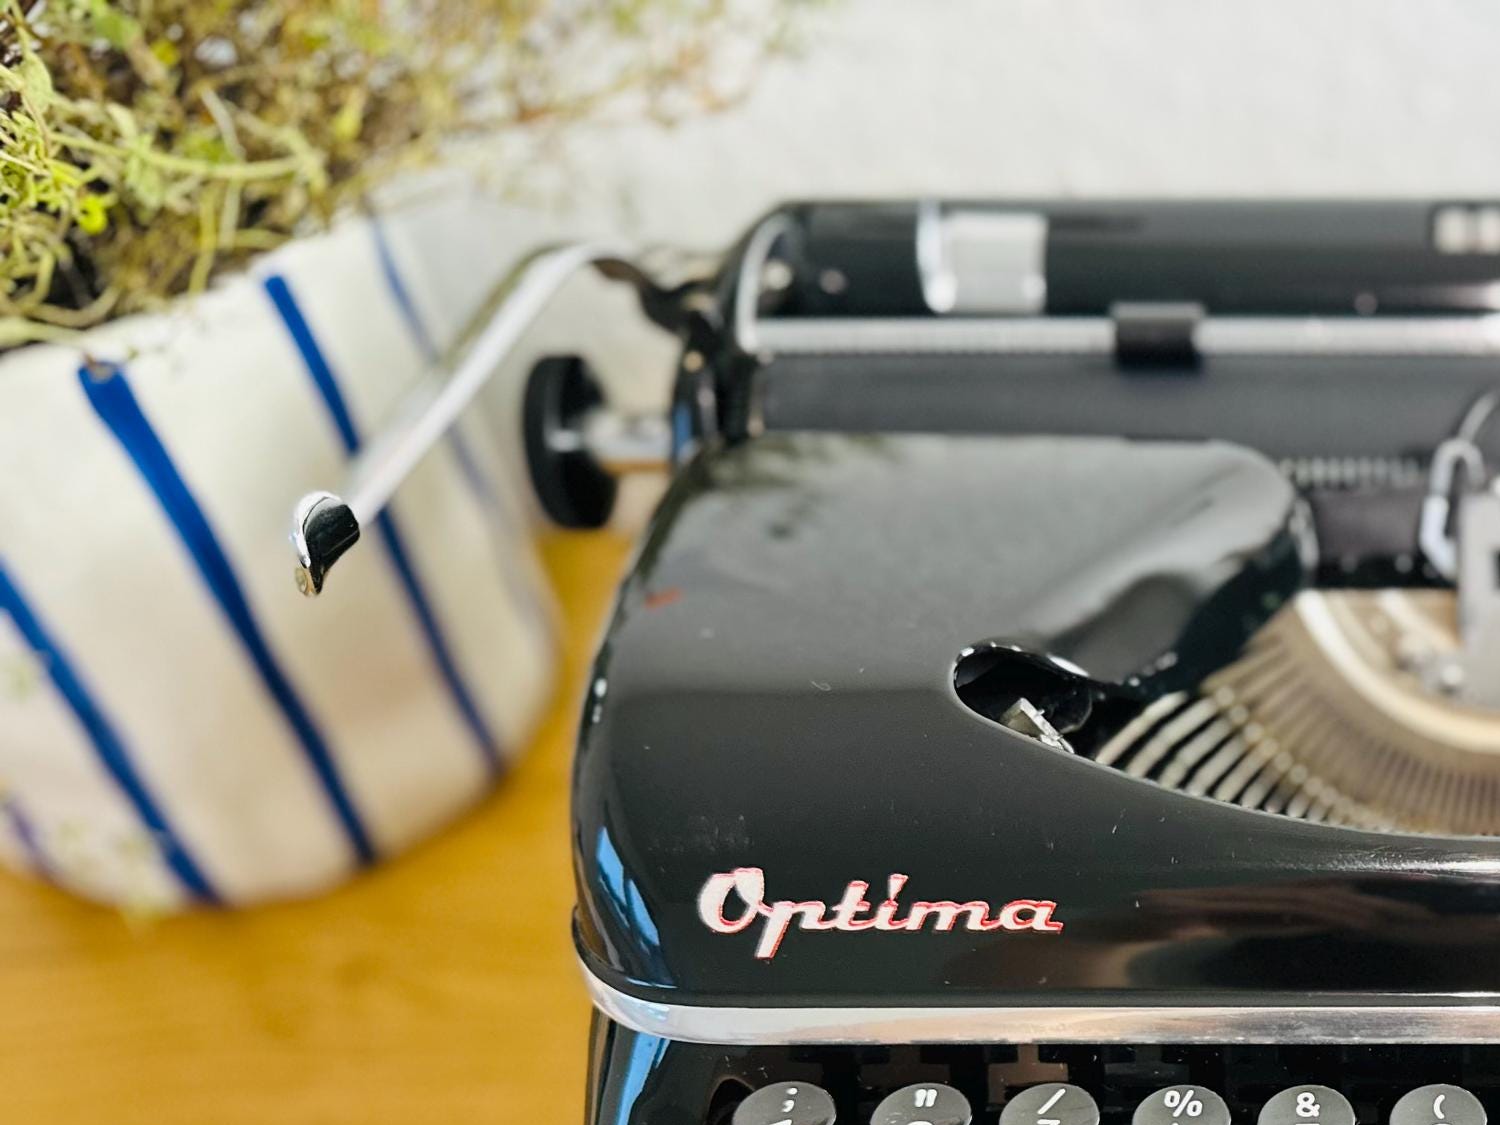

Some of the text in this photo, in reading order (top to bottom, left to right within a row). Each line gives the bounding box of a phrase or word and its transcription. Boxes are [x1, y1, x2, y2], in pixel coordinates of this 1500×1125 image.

[698, 867, 1063, 959] Optima
[914, 1088, 938, 1108] "
[1037, 1088, 1066, 1115] /
[1163, 1089, 1203, 1118] %
[1295, 1092, 1321, 1118] &
[1433, 1094, 1445, 1120] (
